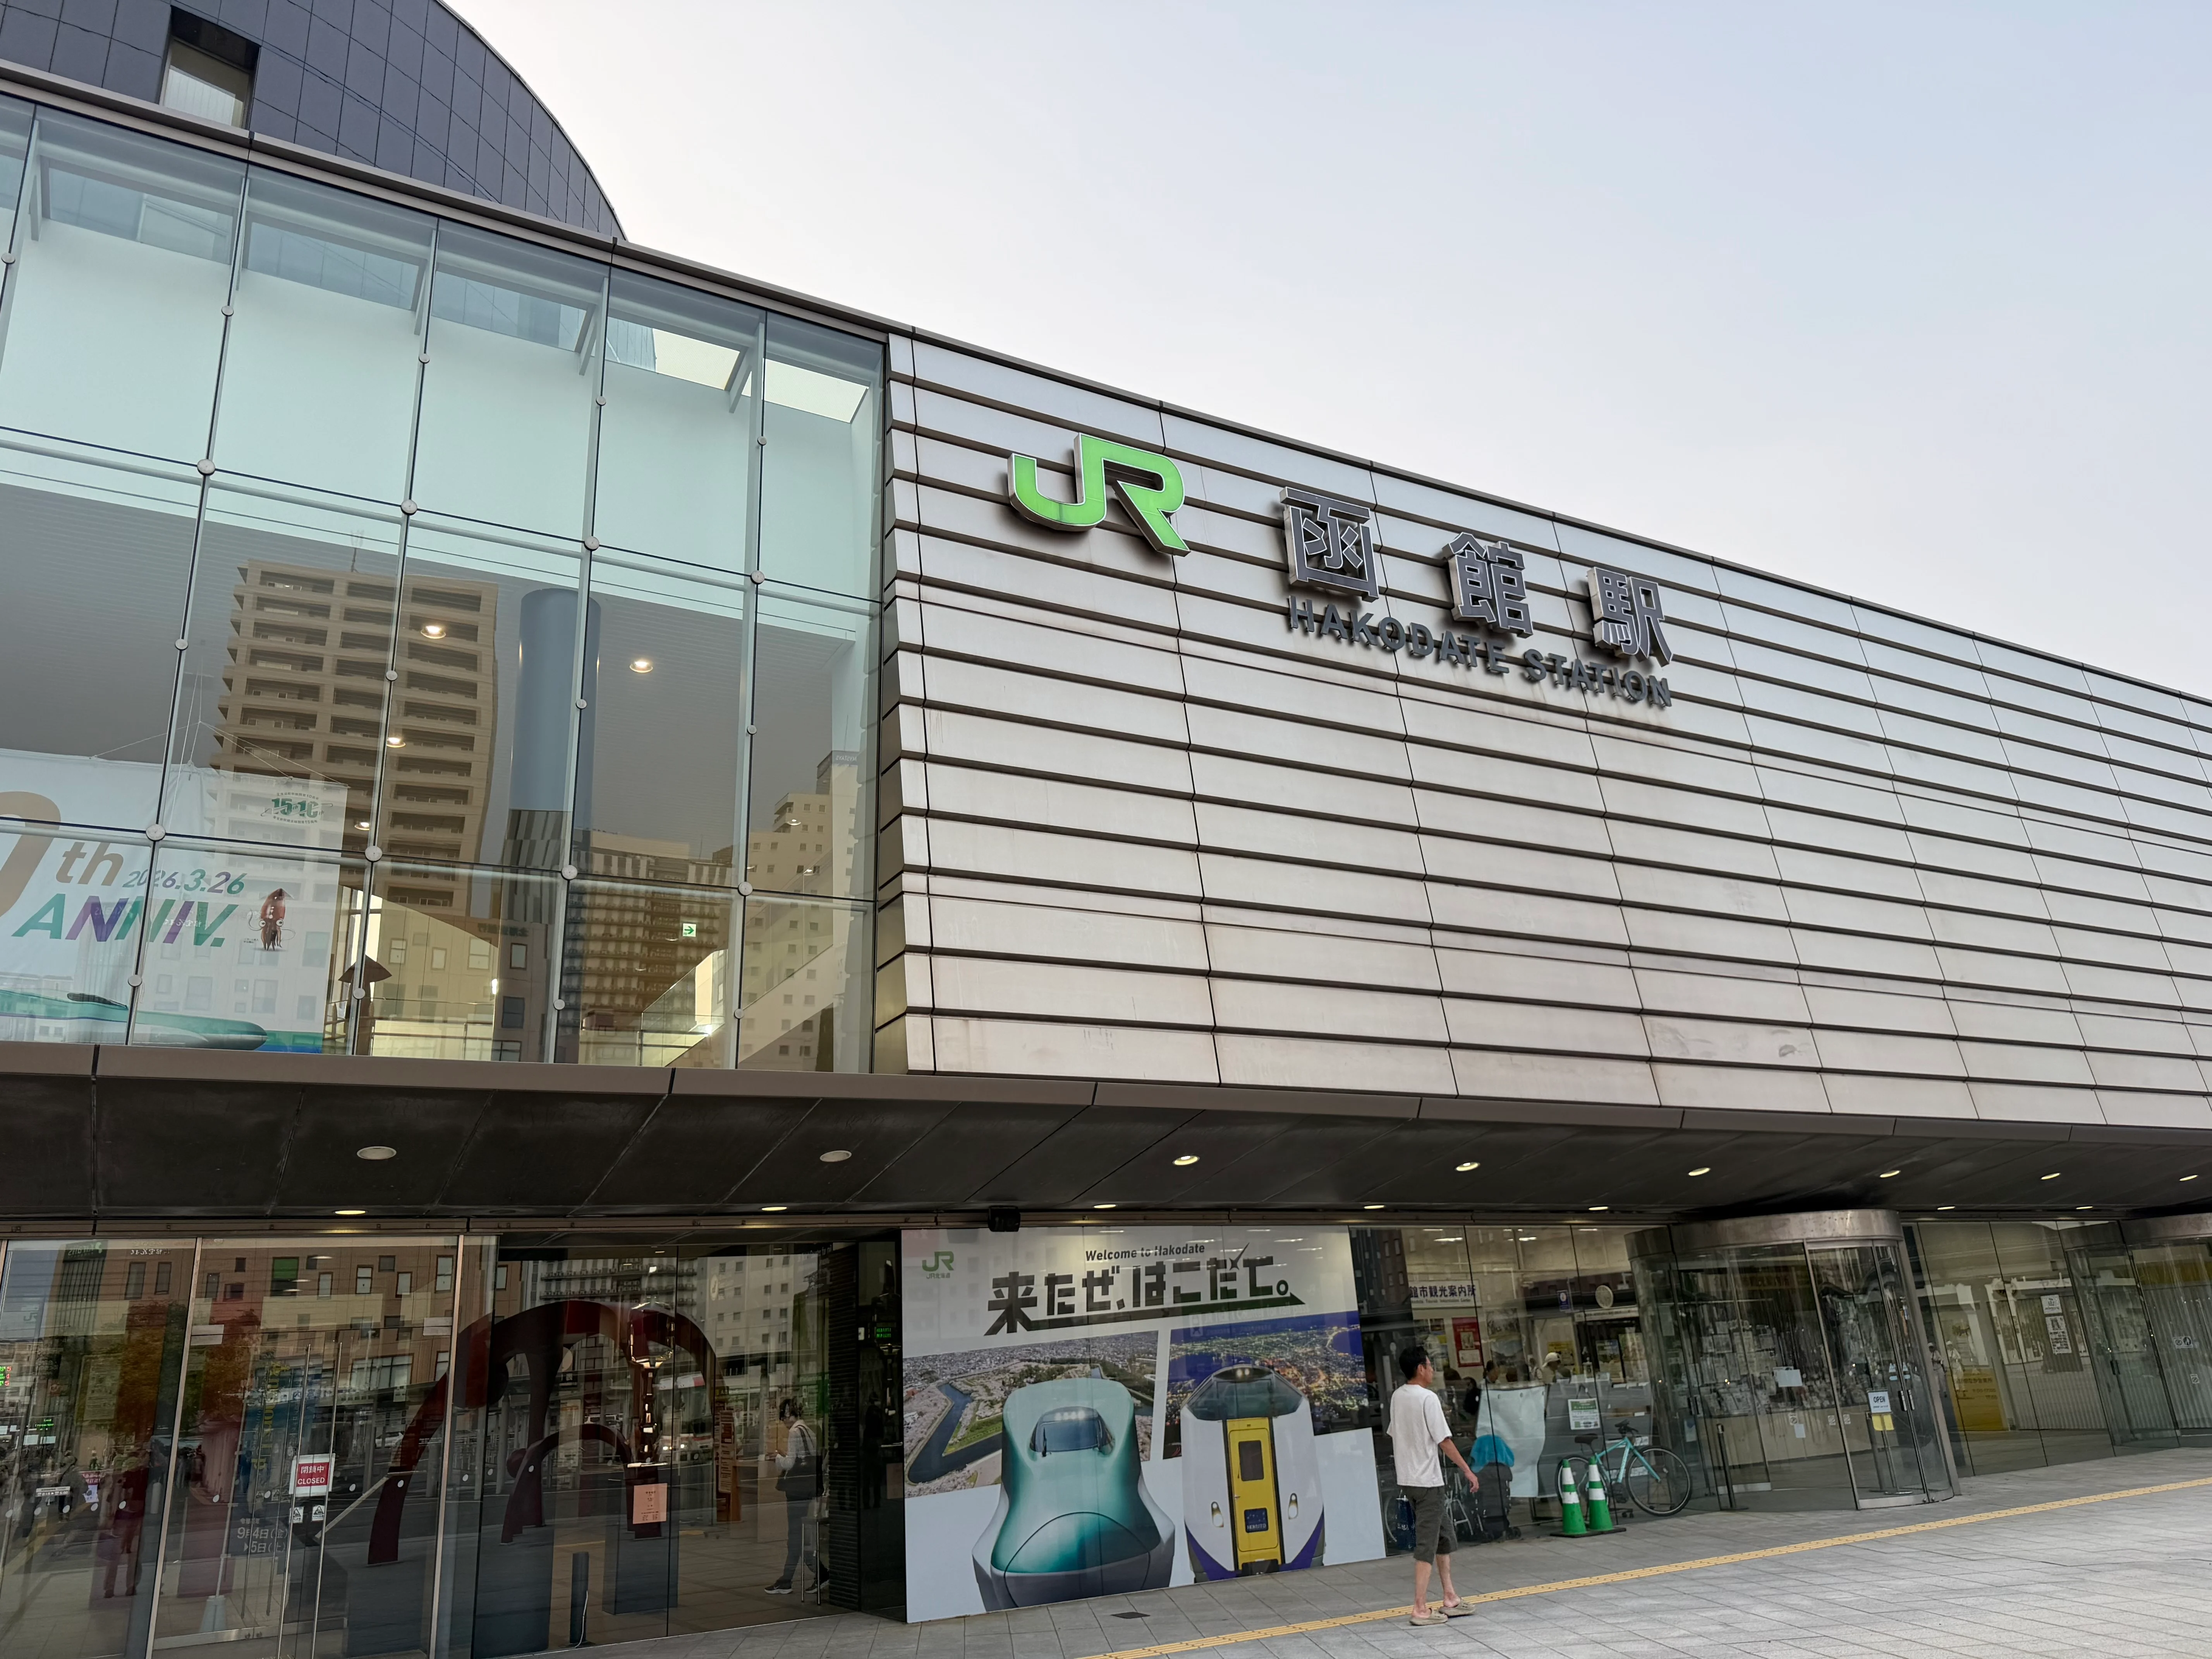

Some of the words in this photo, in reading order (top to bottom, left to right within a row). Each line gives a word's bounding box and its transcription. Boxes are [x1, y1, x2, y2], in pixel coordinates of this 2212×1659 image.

[1008, 432, 1190, 557] JR
[1280, 486, 1674, 667] 函館駅
[1289, 595, 1510, 674] HAKODATE
[1523, 648, 1673, 708] STATION
[122, 869, 247, 895] 2026.3.26
[11, 893, 239, 947] ANNIV.
[922, 1251, 954, 1272] JR
[1085, 1249, 1137, 1261] Welcome
[1141, 1247, 1151, 1257] to
[1154, 1243, 1205, 1256] Hakodate
[1410, 1285, 1476, 1298] 館市観光案内所
[301, 1465, 325, 1474] 閉鎖中
